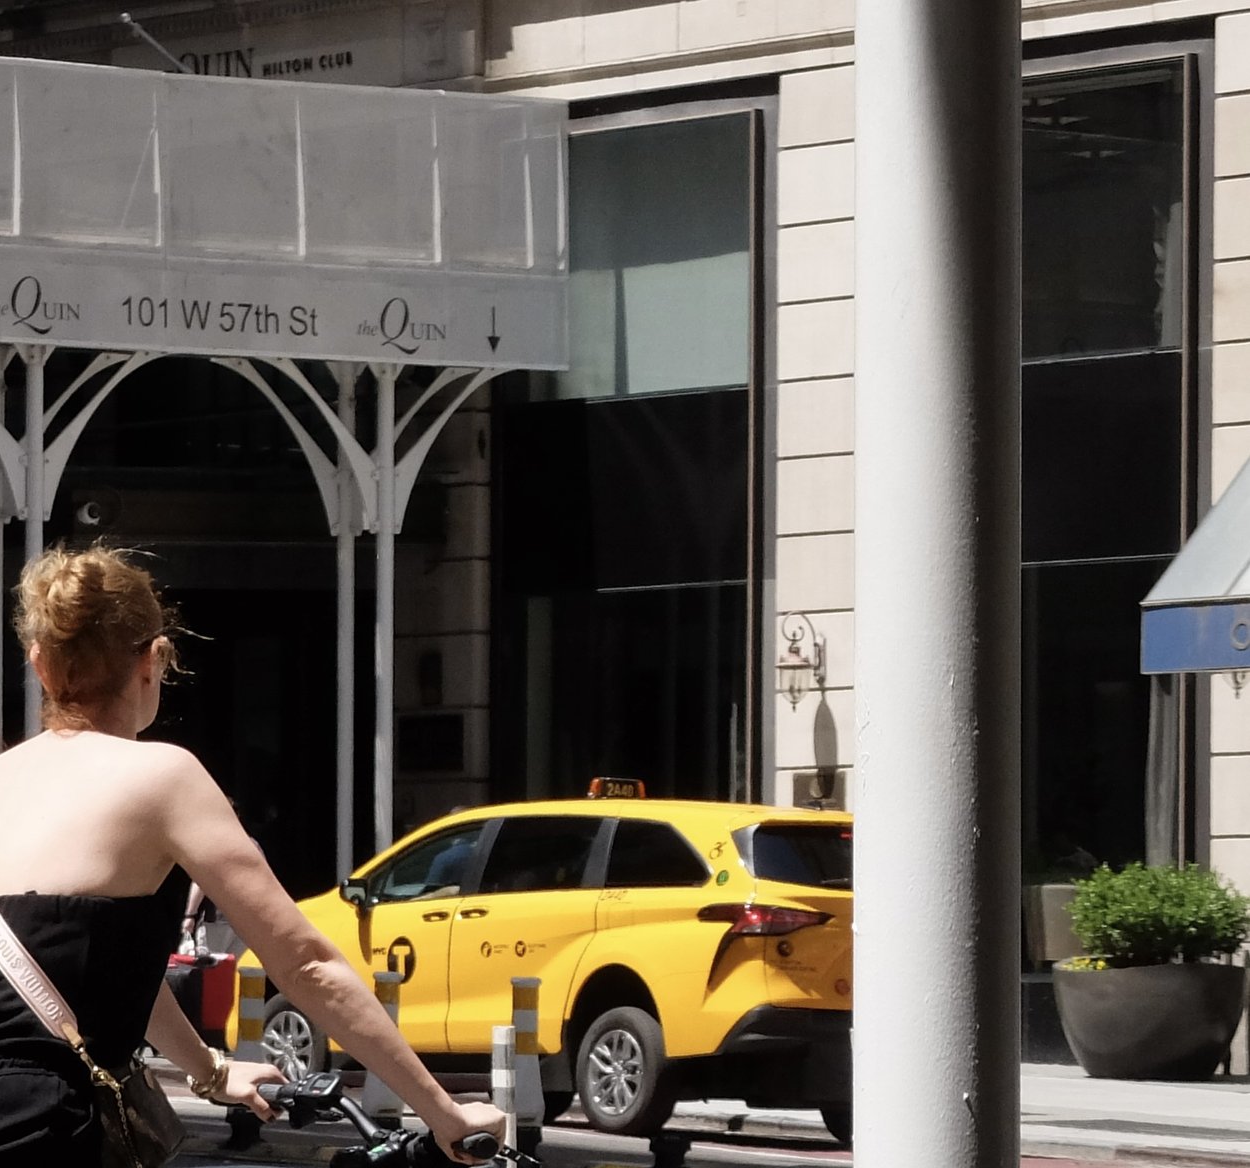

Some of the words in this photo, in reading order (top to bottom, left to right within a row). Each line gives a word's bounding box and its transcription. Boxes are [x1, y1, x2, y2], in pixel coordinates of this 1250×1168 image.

[263, 57, 313, 76] HILTON
[319, 51, 353, 69] CLUB
[10, 275, 81, 334] QUIN
[121, 296, 168, 328] 101
[181, 300, 211, 330] W
[219, 302, 280, 334] 57th
[289, 306, 319, 336] St
[357, 320, 378, 337] the
[379, 297, 447, 355] QUIN
